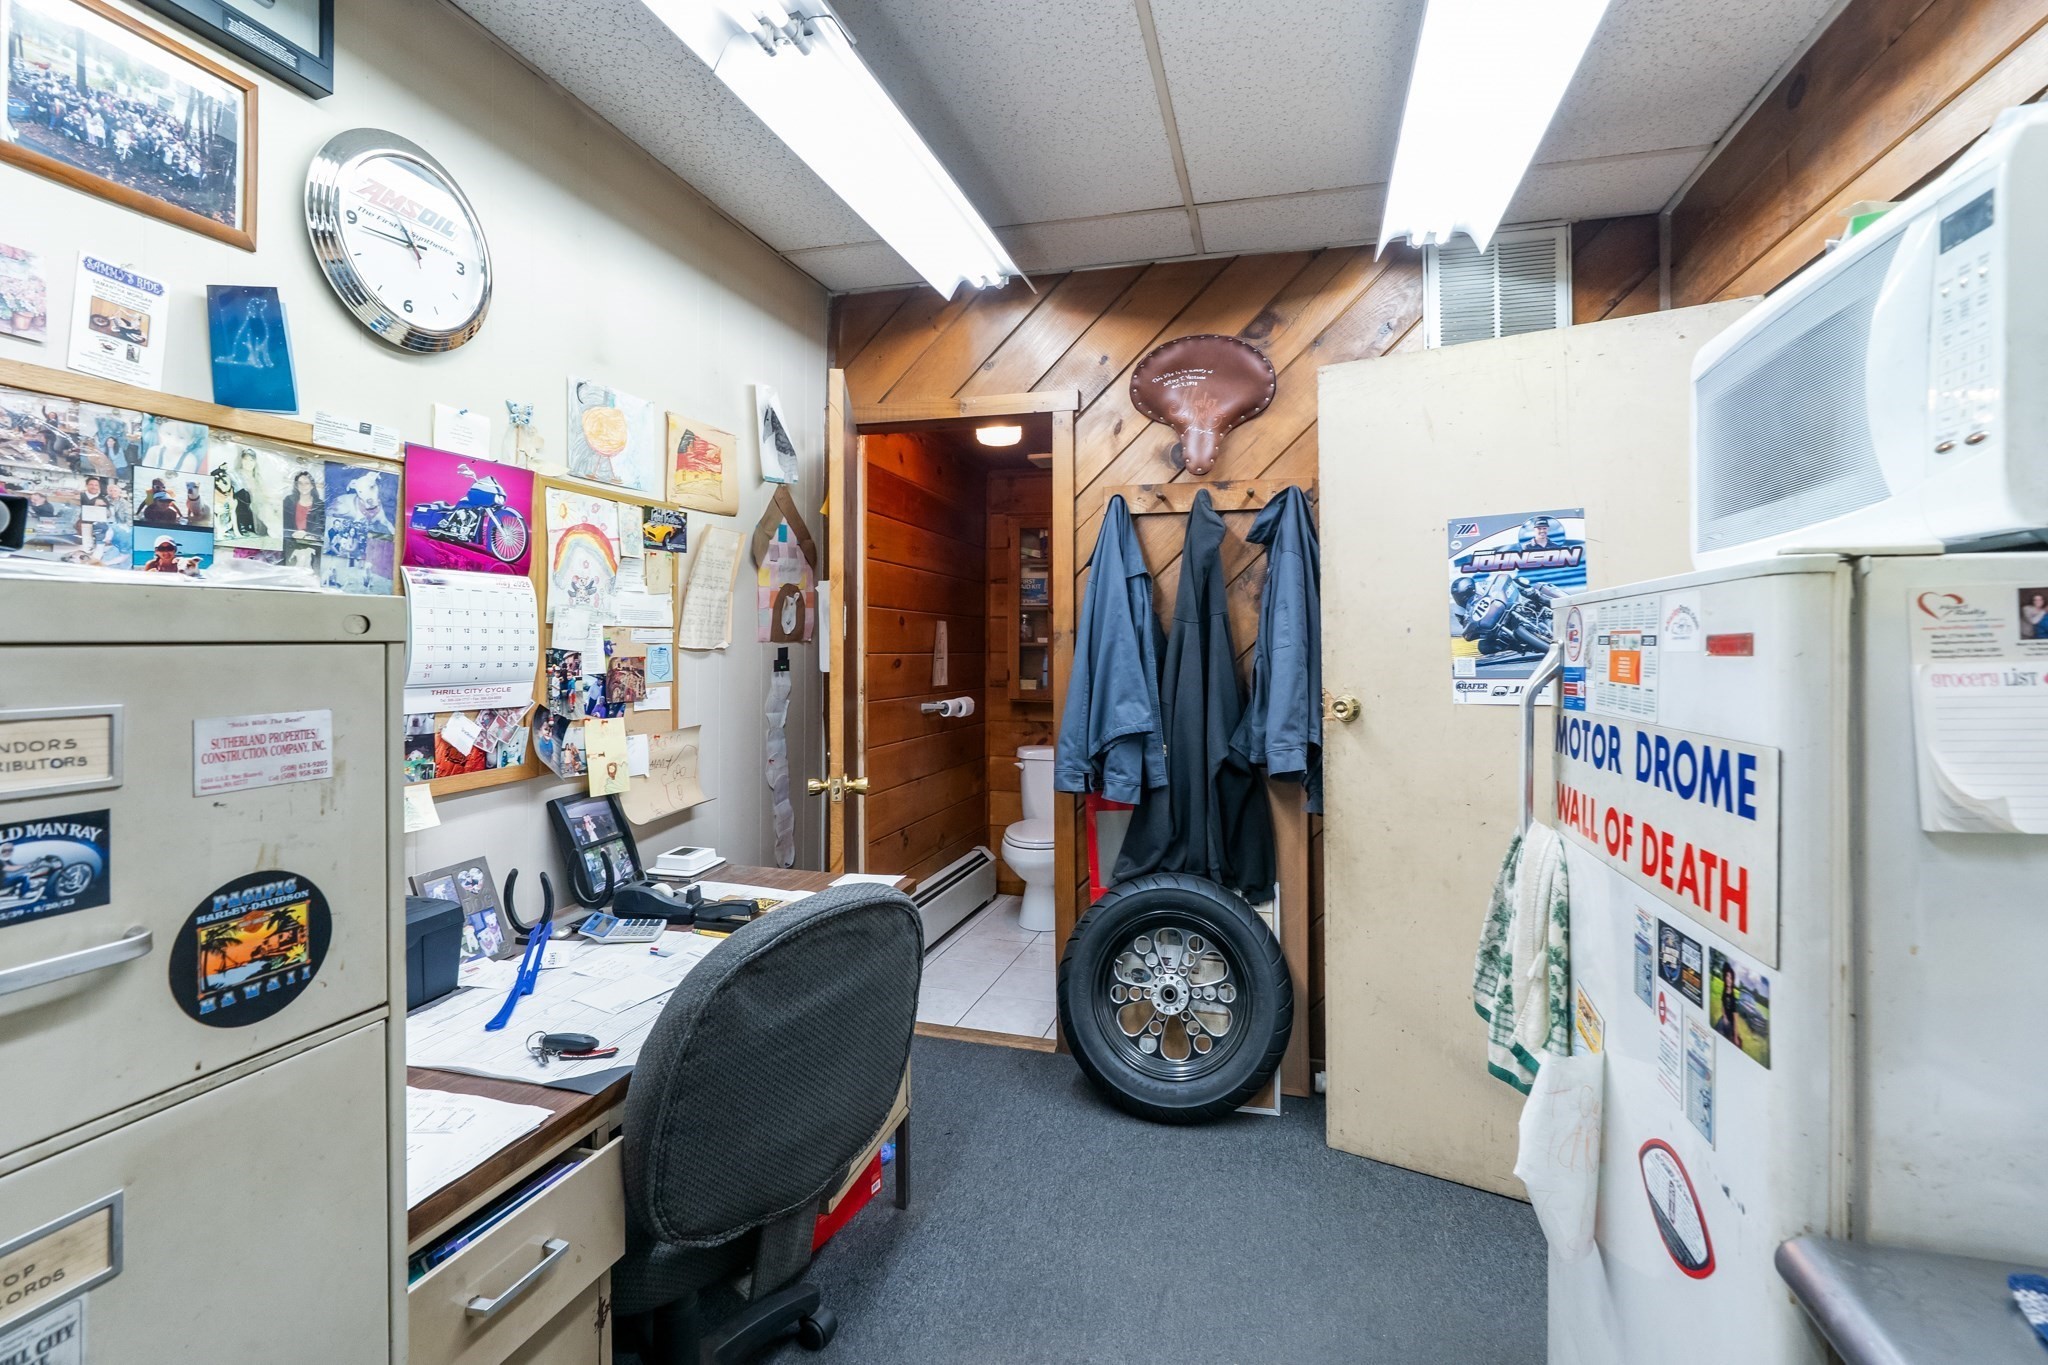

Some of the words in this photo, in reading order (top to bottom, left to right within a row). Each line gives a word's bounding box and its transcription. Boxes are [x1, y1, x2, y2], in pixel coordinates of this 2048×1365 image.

[346, 210, 358, 224] 9
[356, 178, 456, 237] AMSOIL
[358, 206, 374, 217] The
[377, 215, 399, 229] First
[410, 231, 455, 256] Synthetics
[86, 256, 135, 284] SAMMY'S
[136, 278, 163, 296] RIDE
[456, 261, 466, 276] 3
[403, 300, 414, 313] 6
[1462, 547, 1582, 573] JOHNSON
[1473, 600, 1491, 618] 713
[1931, 672, 2000, 688] grocery
[201, 747, 268, 765] CONSTRUCTION
[270, 742, 310, 757] COMPANY,
[312, 740, 327, 751] INC.
[211, 734, 266, 750] SUTHERLAND
[281, 764, 297, 773] (508)
[1556, 714, 1622, 775] MOTOR
[1636, 730, 1757, 821] DROME
[25, 822, 68, 839] MAN
[69, 823, 103, 842] RAY
[1556, 780, 1599, 845] WALL
[1604, 807, 1633, 863] OF
[1641, 821, 1748, 935] DEATH
[196, 889, 310, 925] HARLEY-DAVIDSON
[212, 877, 298, 912] PACIFIC
[199, 966, 312, 1016] HAWAII
[3, 1263, 36, 1288] OP
[36, 1319, 78, 1356] CITY
